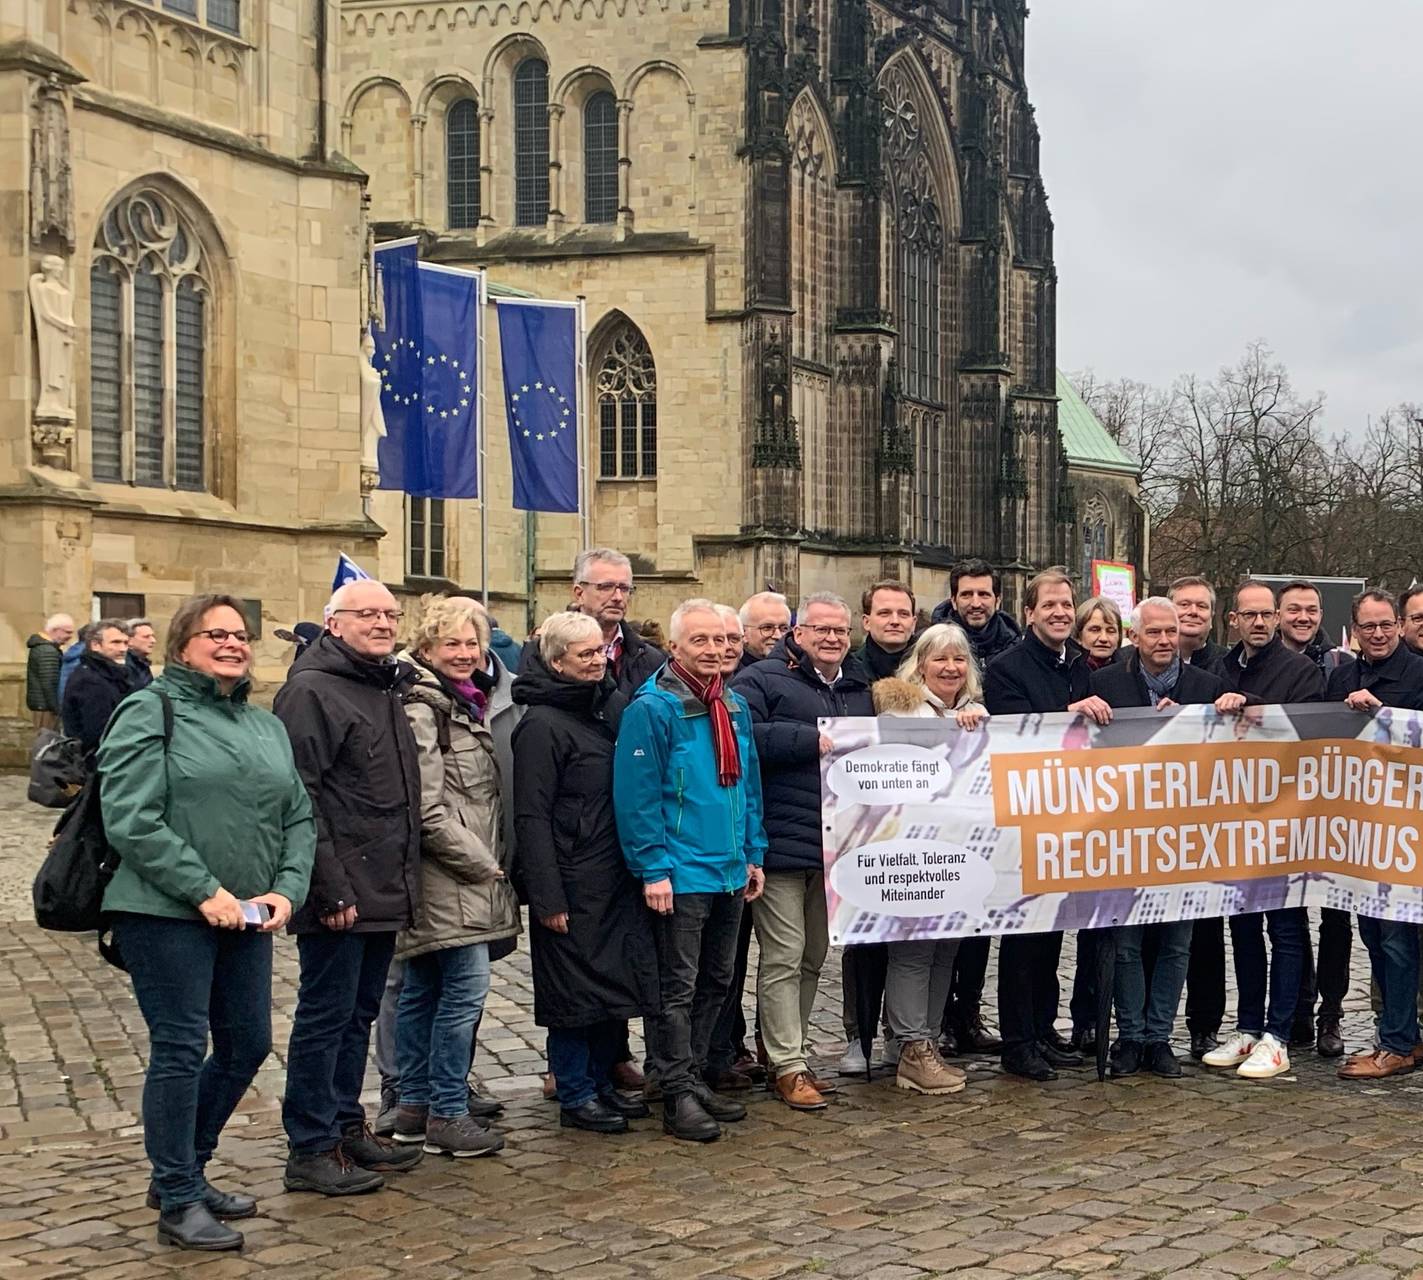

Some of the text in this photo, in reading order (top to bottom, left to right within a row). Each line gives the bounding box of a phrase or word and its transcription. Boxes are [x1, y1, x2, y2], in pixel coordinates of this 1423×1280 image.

[845, 760, 940, 776] Demokratie fängt
[858, 778, 929, 790] von unten an
[1036, 816, 1418, 881] RECHTSEXTREMISMUS
[857, 854, 876, 868] Für
[922, 851, 966, 865] Toleranz
[865, 868, 960, 887] und respektvolles
[881, 887, 945, 902] Miteinander
